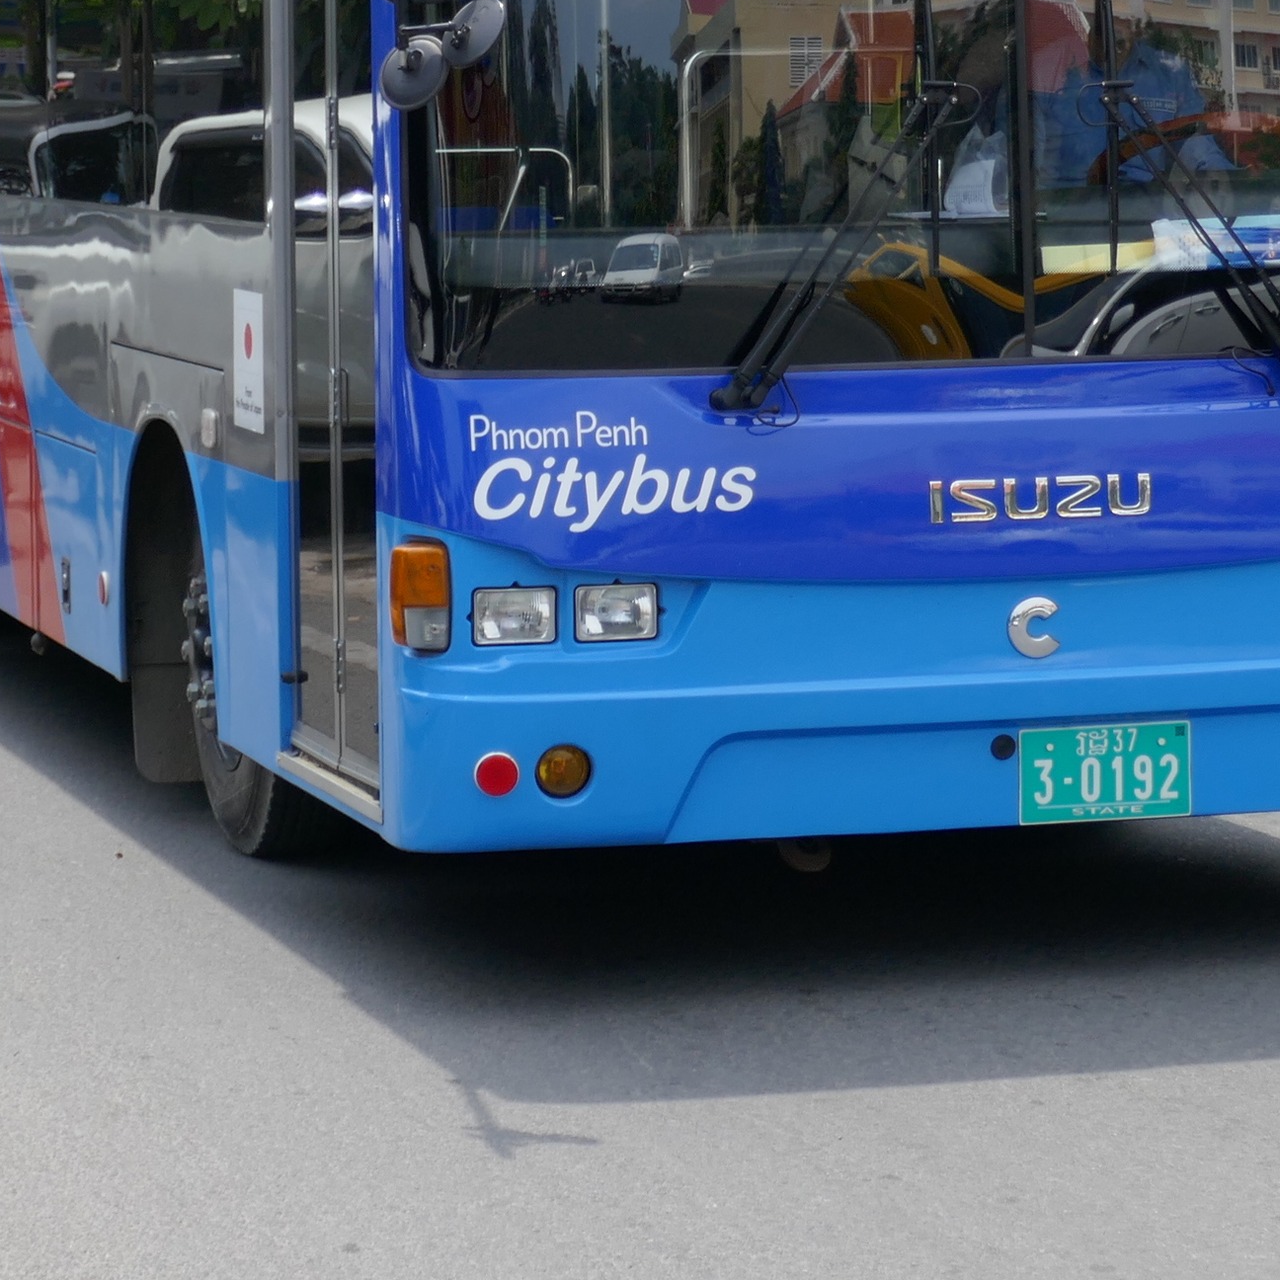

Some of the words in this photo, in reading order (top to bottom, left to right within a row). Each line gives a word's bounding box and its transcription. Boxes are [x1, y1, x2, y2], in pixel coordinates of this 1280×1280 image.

[469, 414, 570, 452] Phnom
[575, 410, 649, 448] Penh
[473, 453, 757, 533] Citybus
[929, 472, 1152, 524] ISUZU
[1033, 754, 1180, 806] 3-0192
[1072, 805, 1143, 816] STATE
